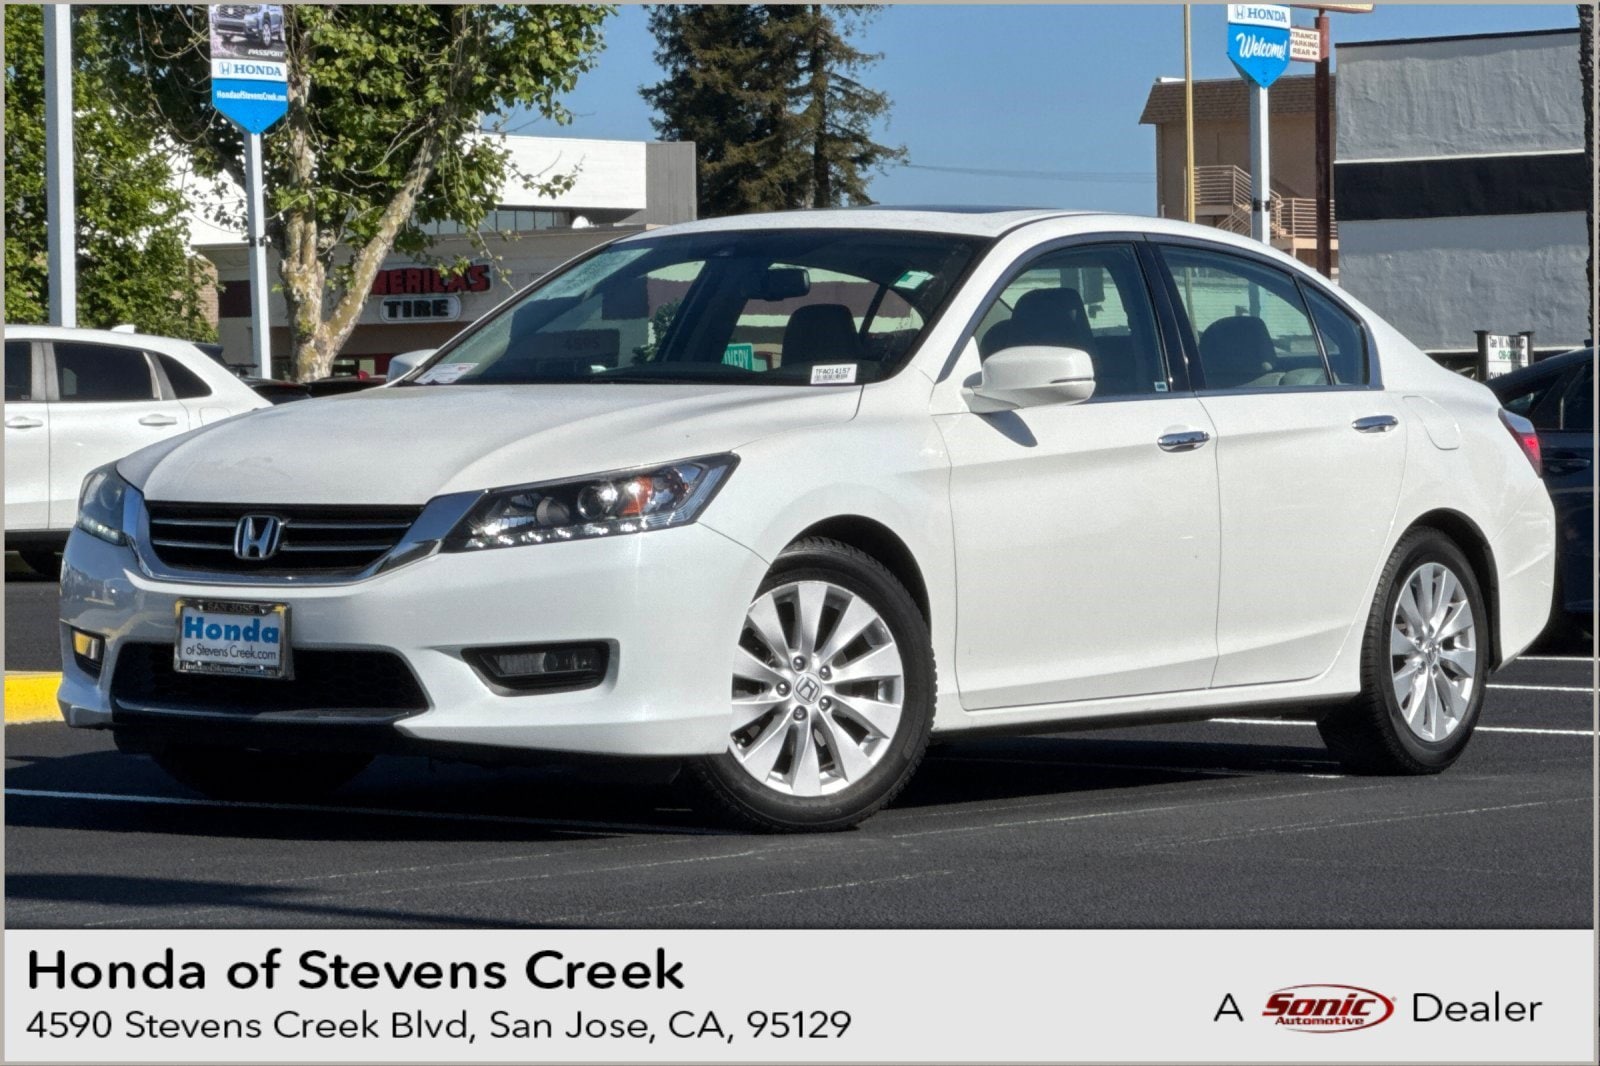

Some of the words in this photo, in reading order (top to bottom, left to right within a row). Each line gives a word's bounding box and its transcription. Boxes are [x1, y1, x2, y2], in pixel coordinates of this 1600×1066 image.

[1247, 8, 1287, 23] HONDA
[247, 48, 284, 57] PASSPORT
[1235, 32, 1287, 61] Welcome!
[1292, 47, 1311, 56] REAR
[233, 64, 283, 77] HONDA
[383, 299, 449, 318] TIRE
[184, 616, 279, 644] Honda
[186, 645, 195, 655] of
[196, 643, 229, 658] Stevens
[229, 644, 276, 660] Creek.com
